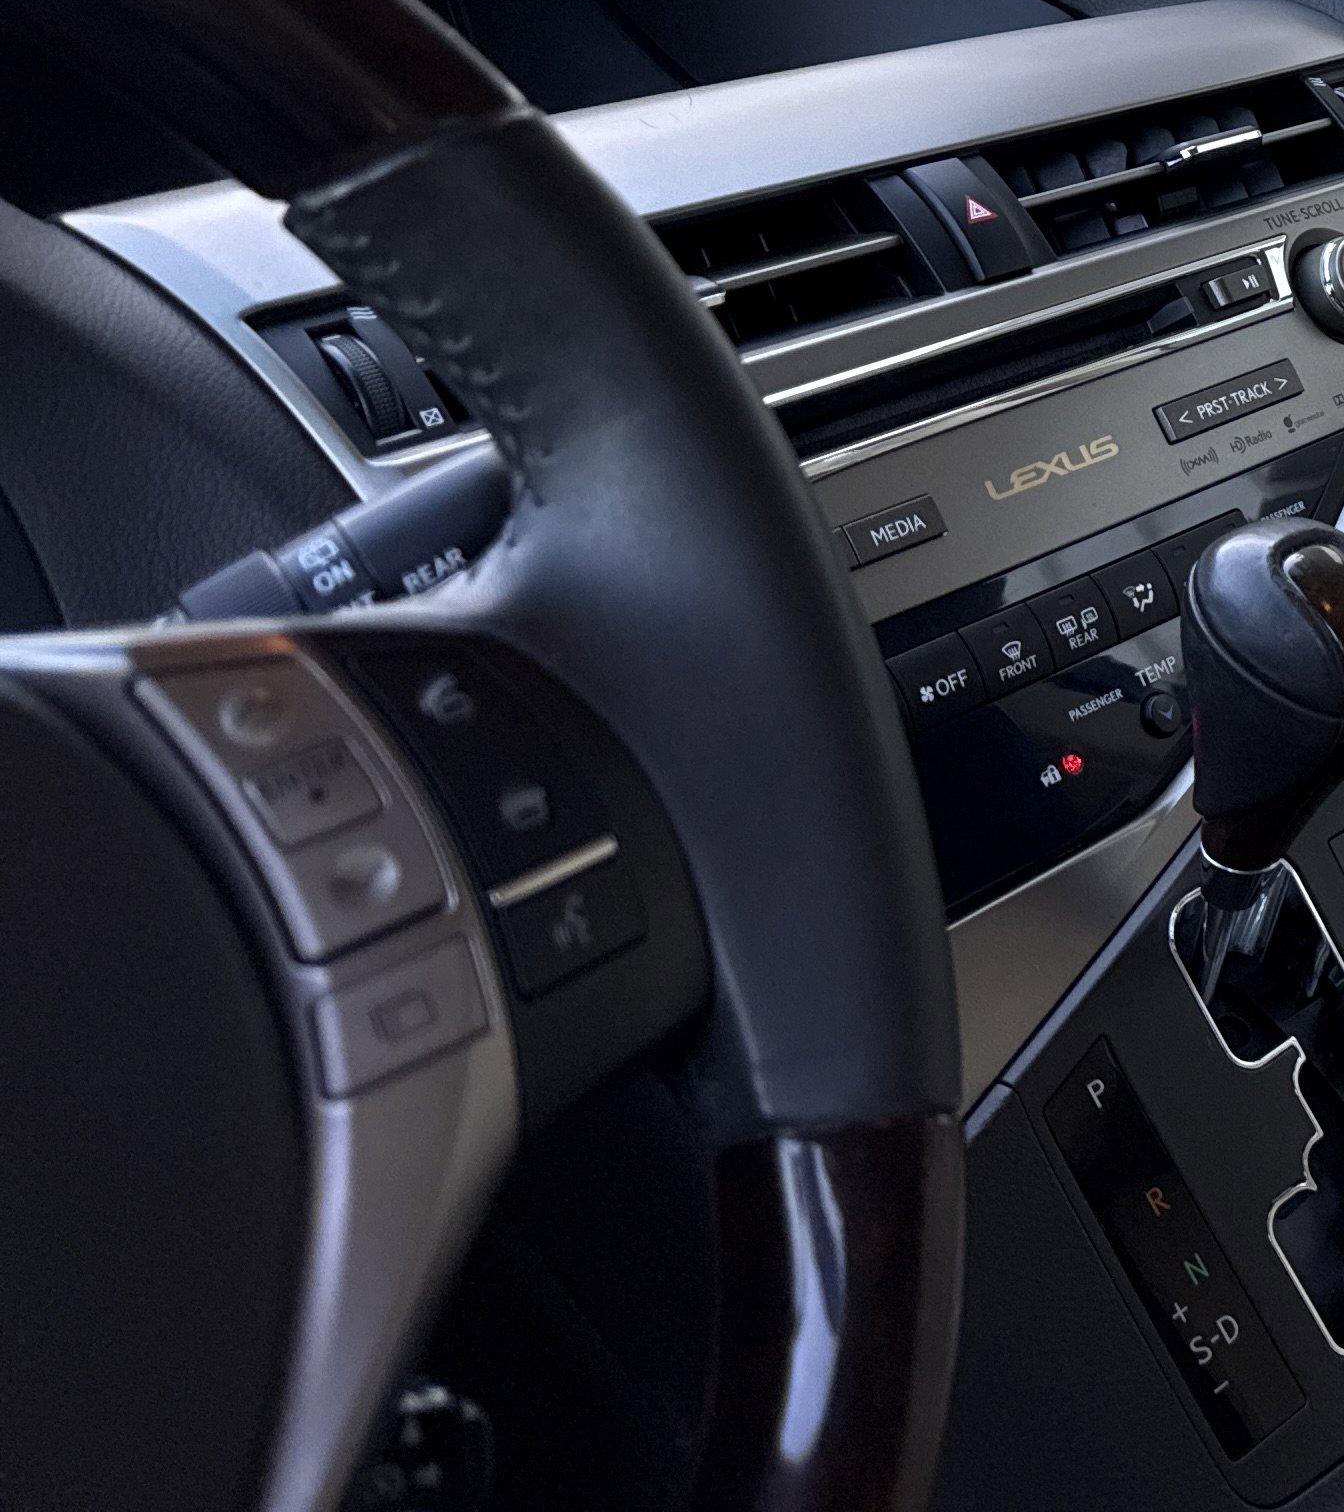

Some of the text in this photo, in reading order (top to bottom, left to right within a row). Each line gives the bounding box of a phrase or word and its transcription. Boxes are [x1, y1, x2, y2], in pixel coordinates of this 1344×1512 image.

[1245, 428, 1272, 446] Radio
[984, 434, 1119, 501] LEXUS
[870, 513, 927, 547] MEDIA
[312, 559, 356, 595] ON
[402, 547, 467, 595] REAR
[1069, 628, 1099, 650] REAR
[935, 668, 968, 697] OFF
[999, 654, 1037, 682] FRONT
[1135, 655, 1176, 687] TEMP
[1068, 688, 1123, 722] PASSENGER
[1085, 1078, 1108, 1109] P
[1145, 1187, 1172, 1217] R
[1183, 1252, 1210, 1286] N
